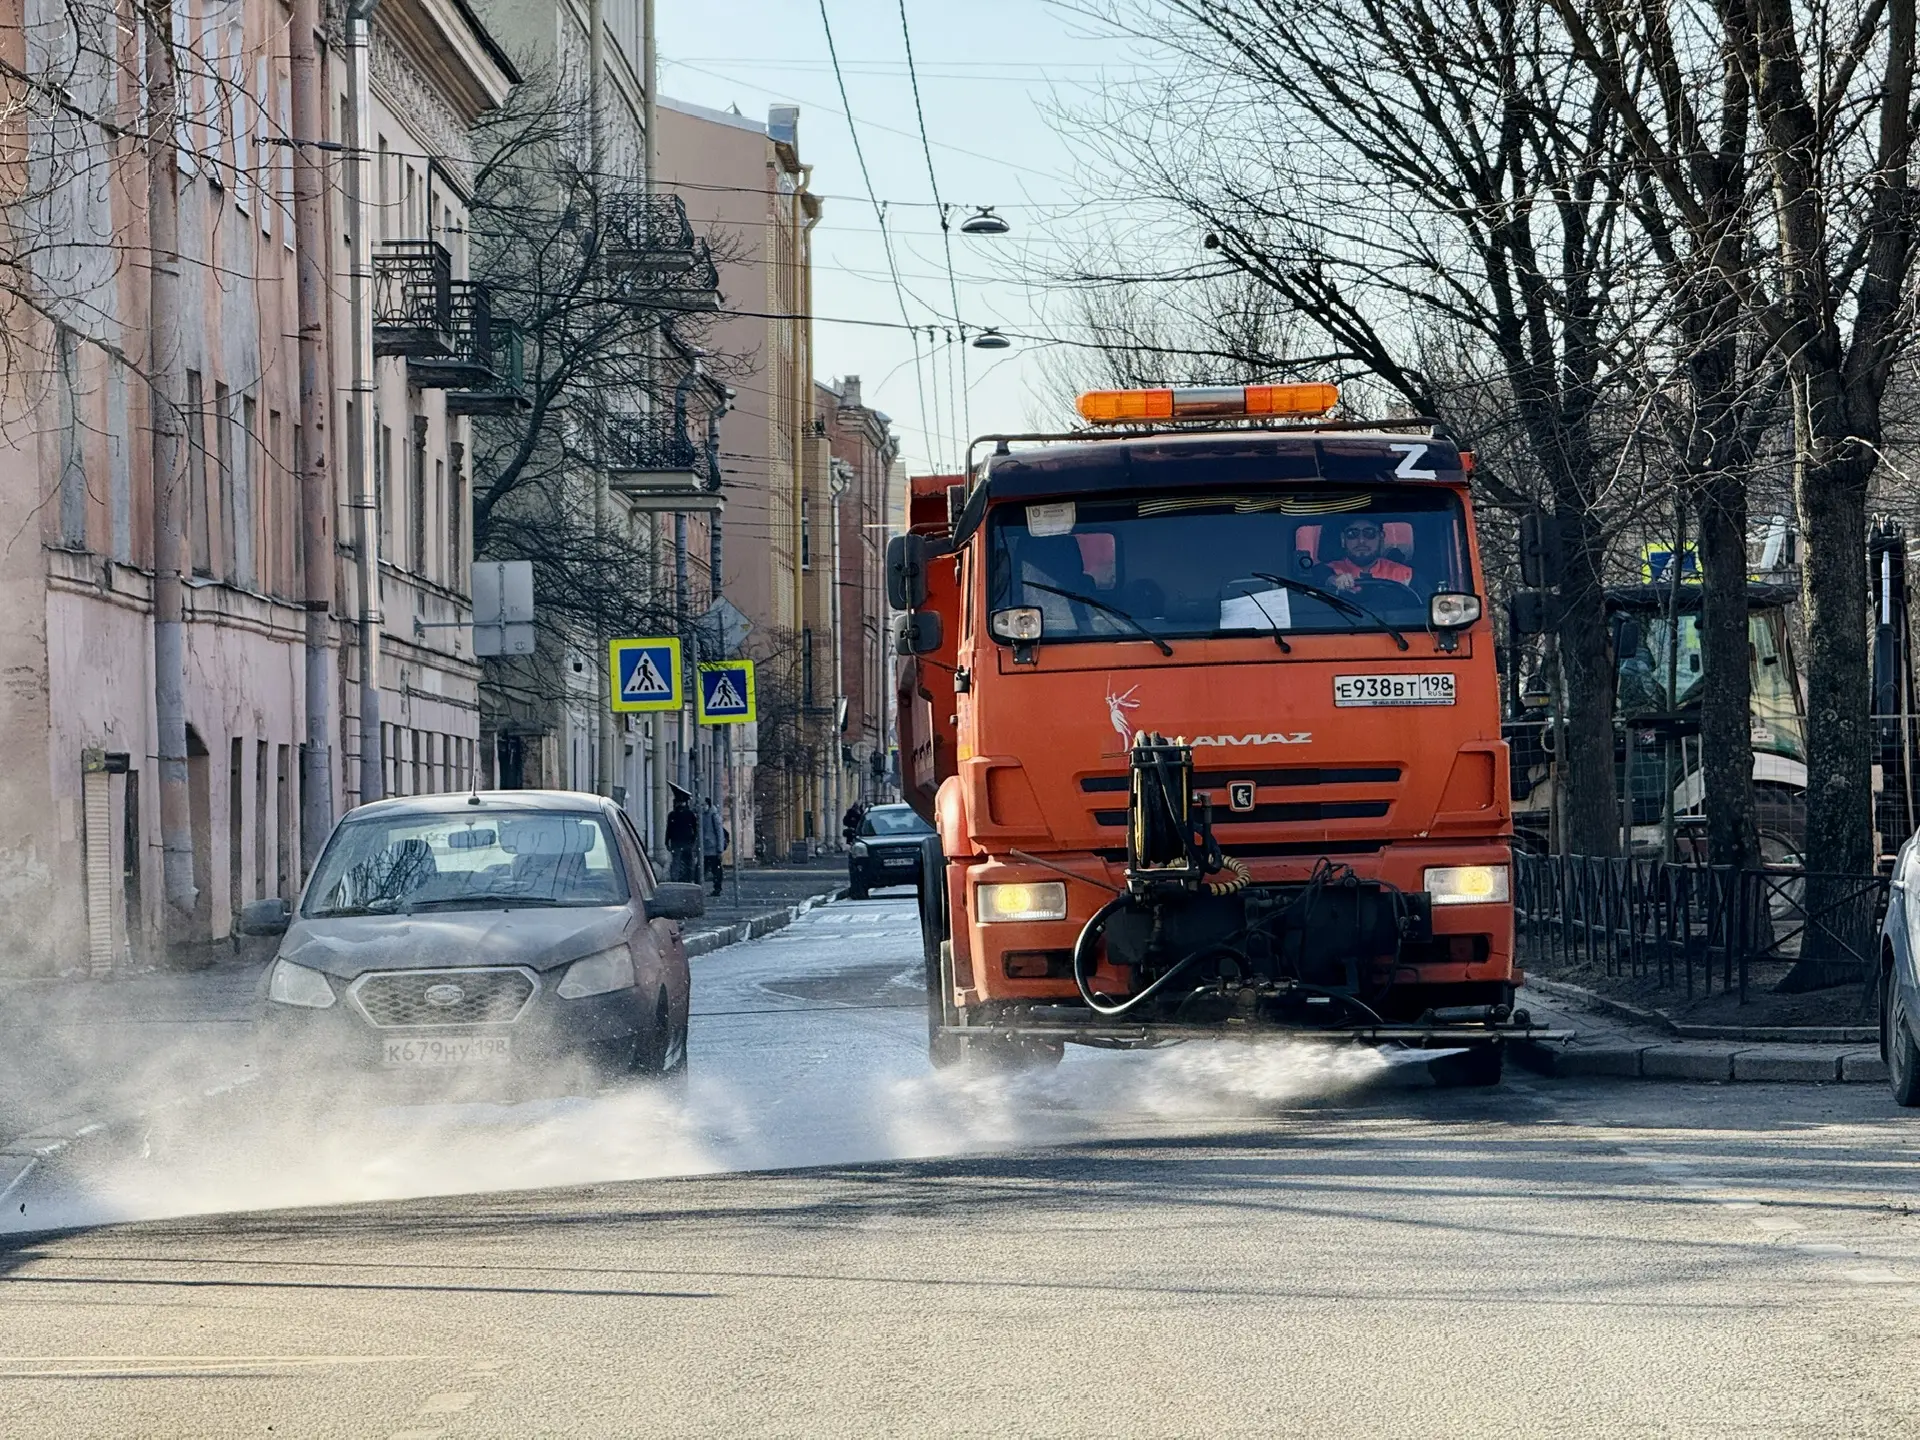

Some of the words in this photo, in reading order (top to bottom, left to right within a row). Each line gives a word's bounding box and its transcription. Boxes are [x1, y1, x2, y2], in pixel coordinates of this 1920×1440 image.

[1389, 443, 1437, 480] Z
[1341, 678, 1417, 698] Е938ВТ
[1421, 676, 1450, 691] 198
